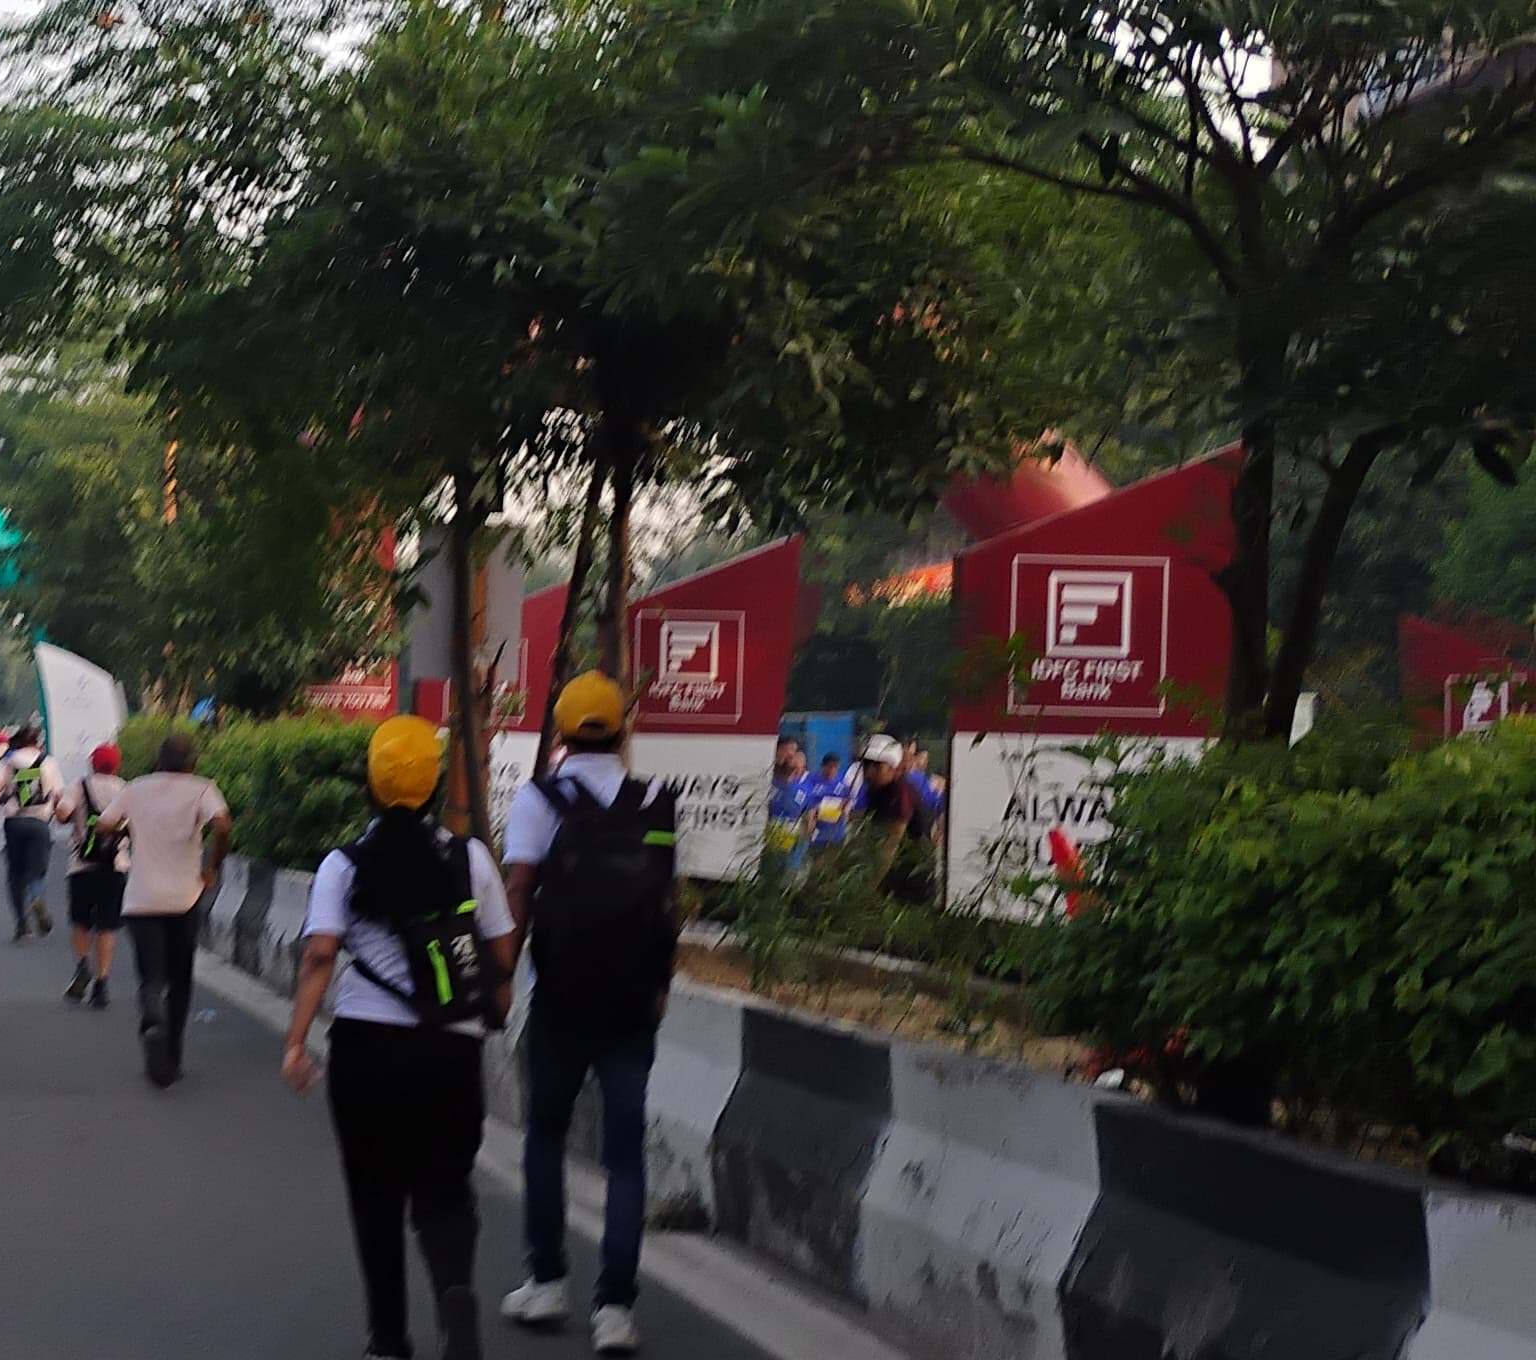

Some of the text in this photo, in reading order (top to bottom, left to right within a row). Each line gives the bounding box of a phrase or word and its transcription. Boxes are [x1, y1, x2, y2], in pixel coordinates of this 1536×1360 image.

[1031, 657, 1144, 684] IDFC FIRST
[1060, 677, 1112, 701] Bank
